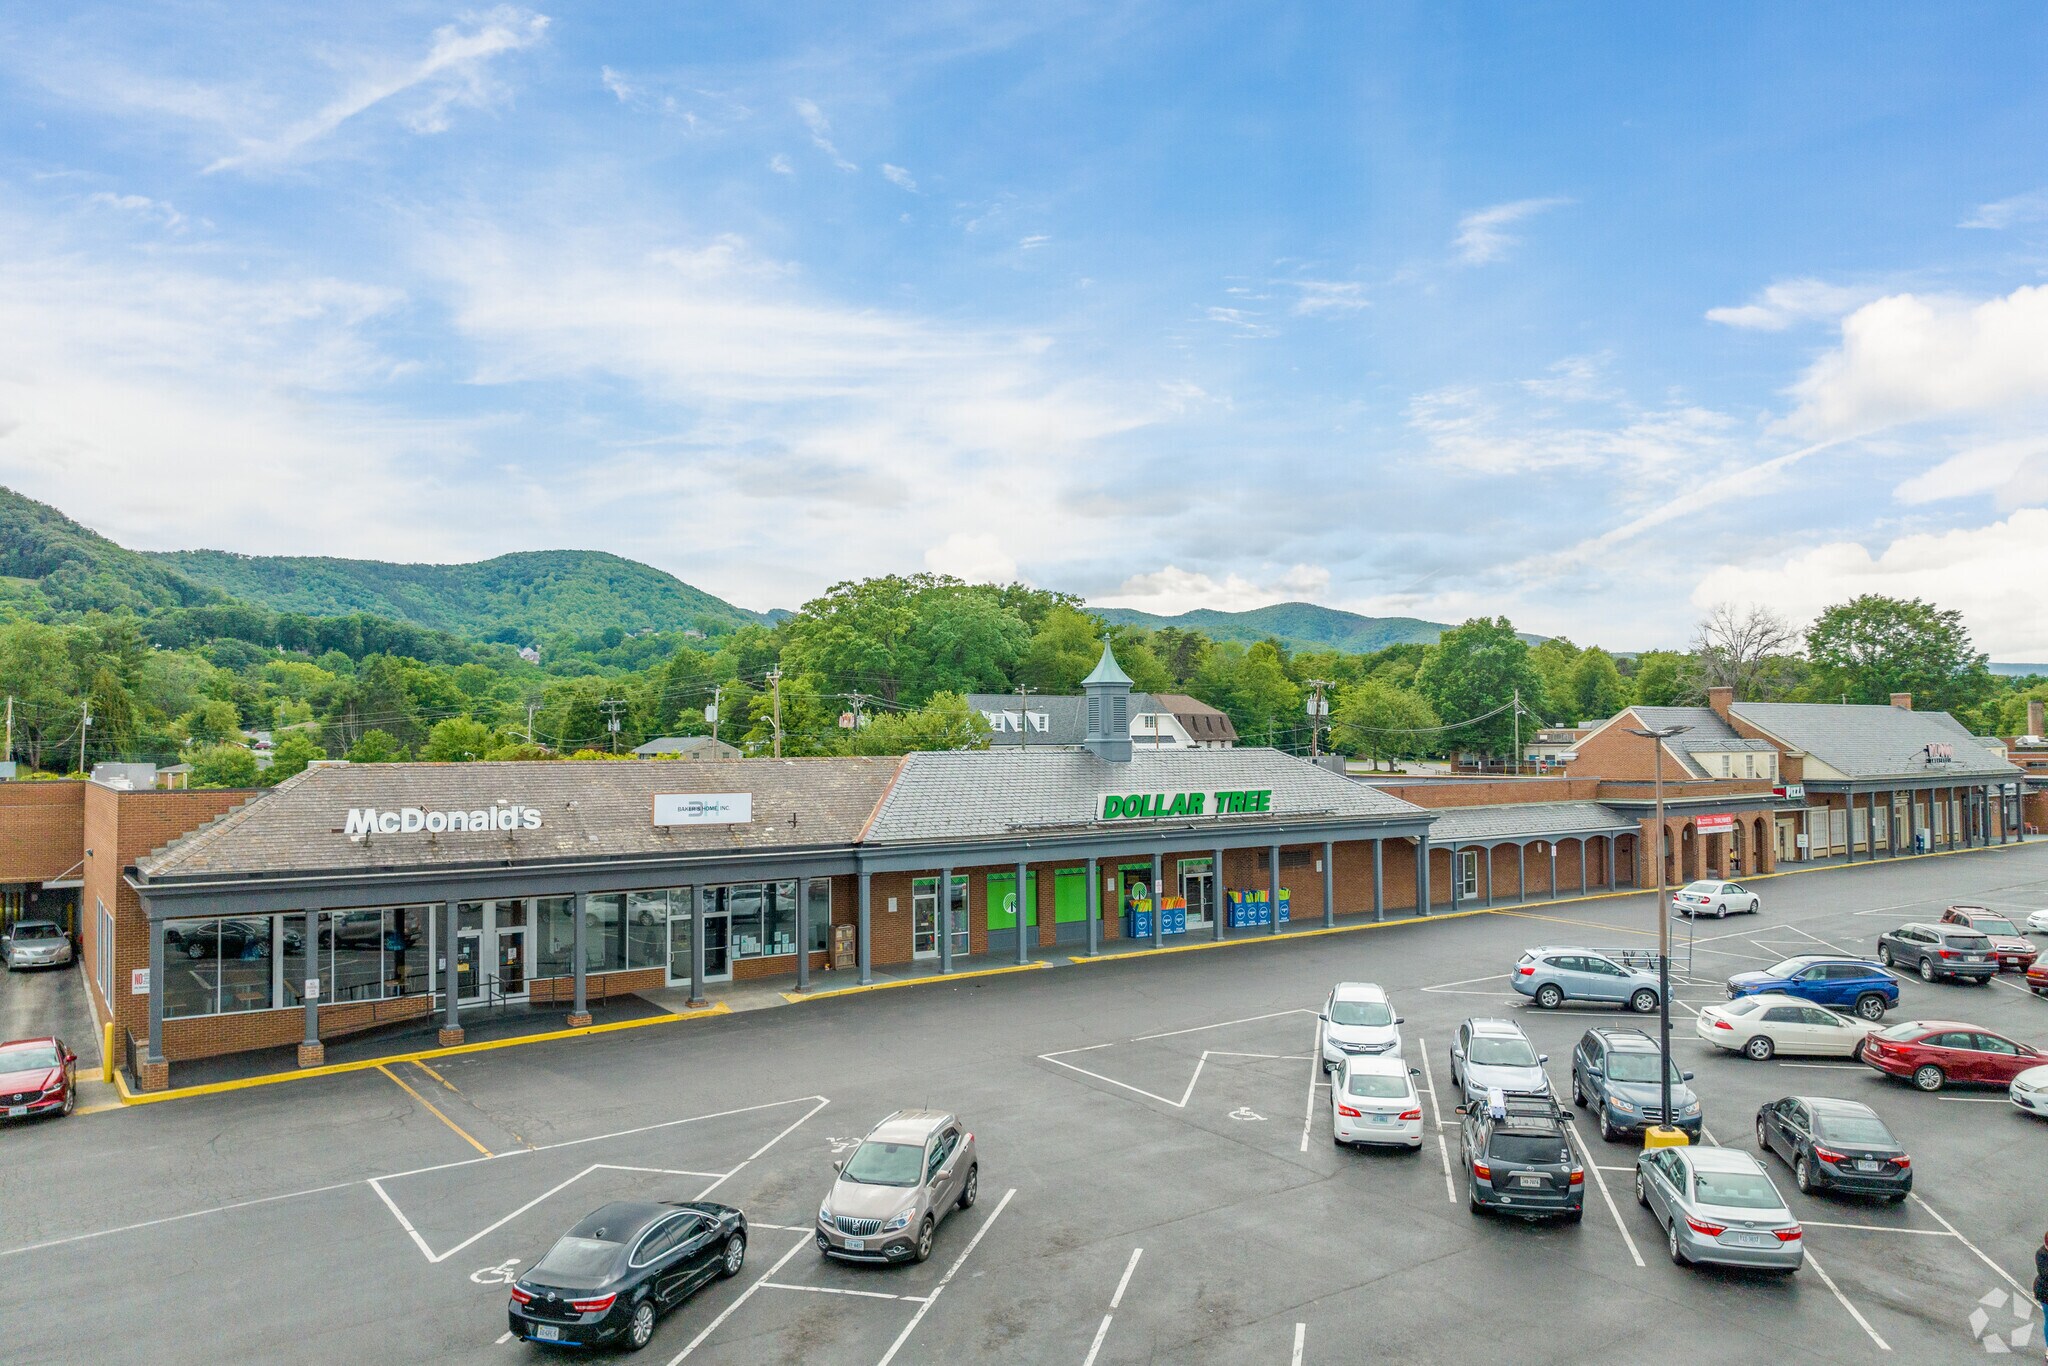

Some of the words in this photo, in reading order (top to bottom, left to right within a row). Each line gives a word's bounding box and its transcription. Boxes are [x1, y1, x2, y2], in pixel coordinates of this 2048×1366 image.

[1103, 792, 1206, 819] DOLLAR
[1214, 789, 1272, 813] TREE
[1787, 786, 1805, 800] PIZZA
[344, 805, 543, 834] McDonald's
